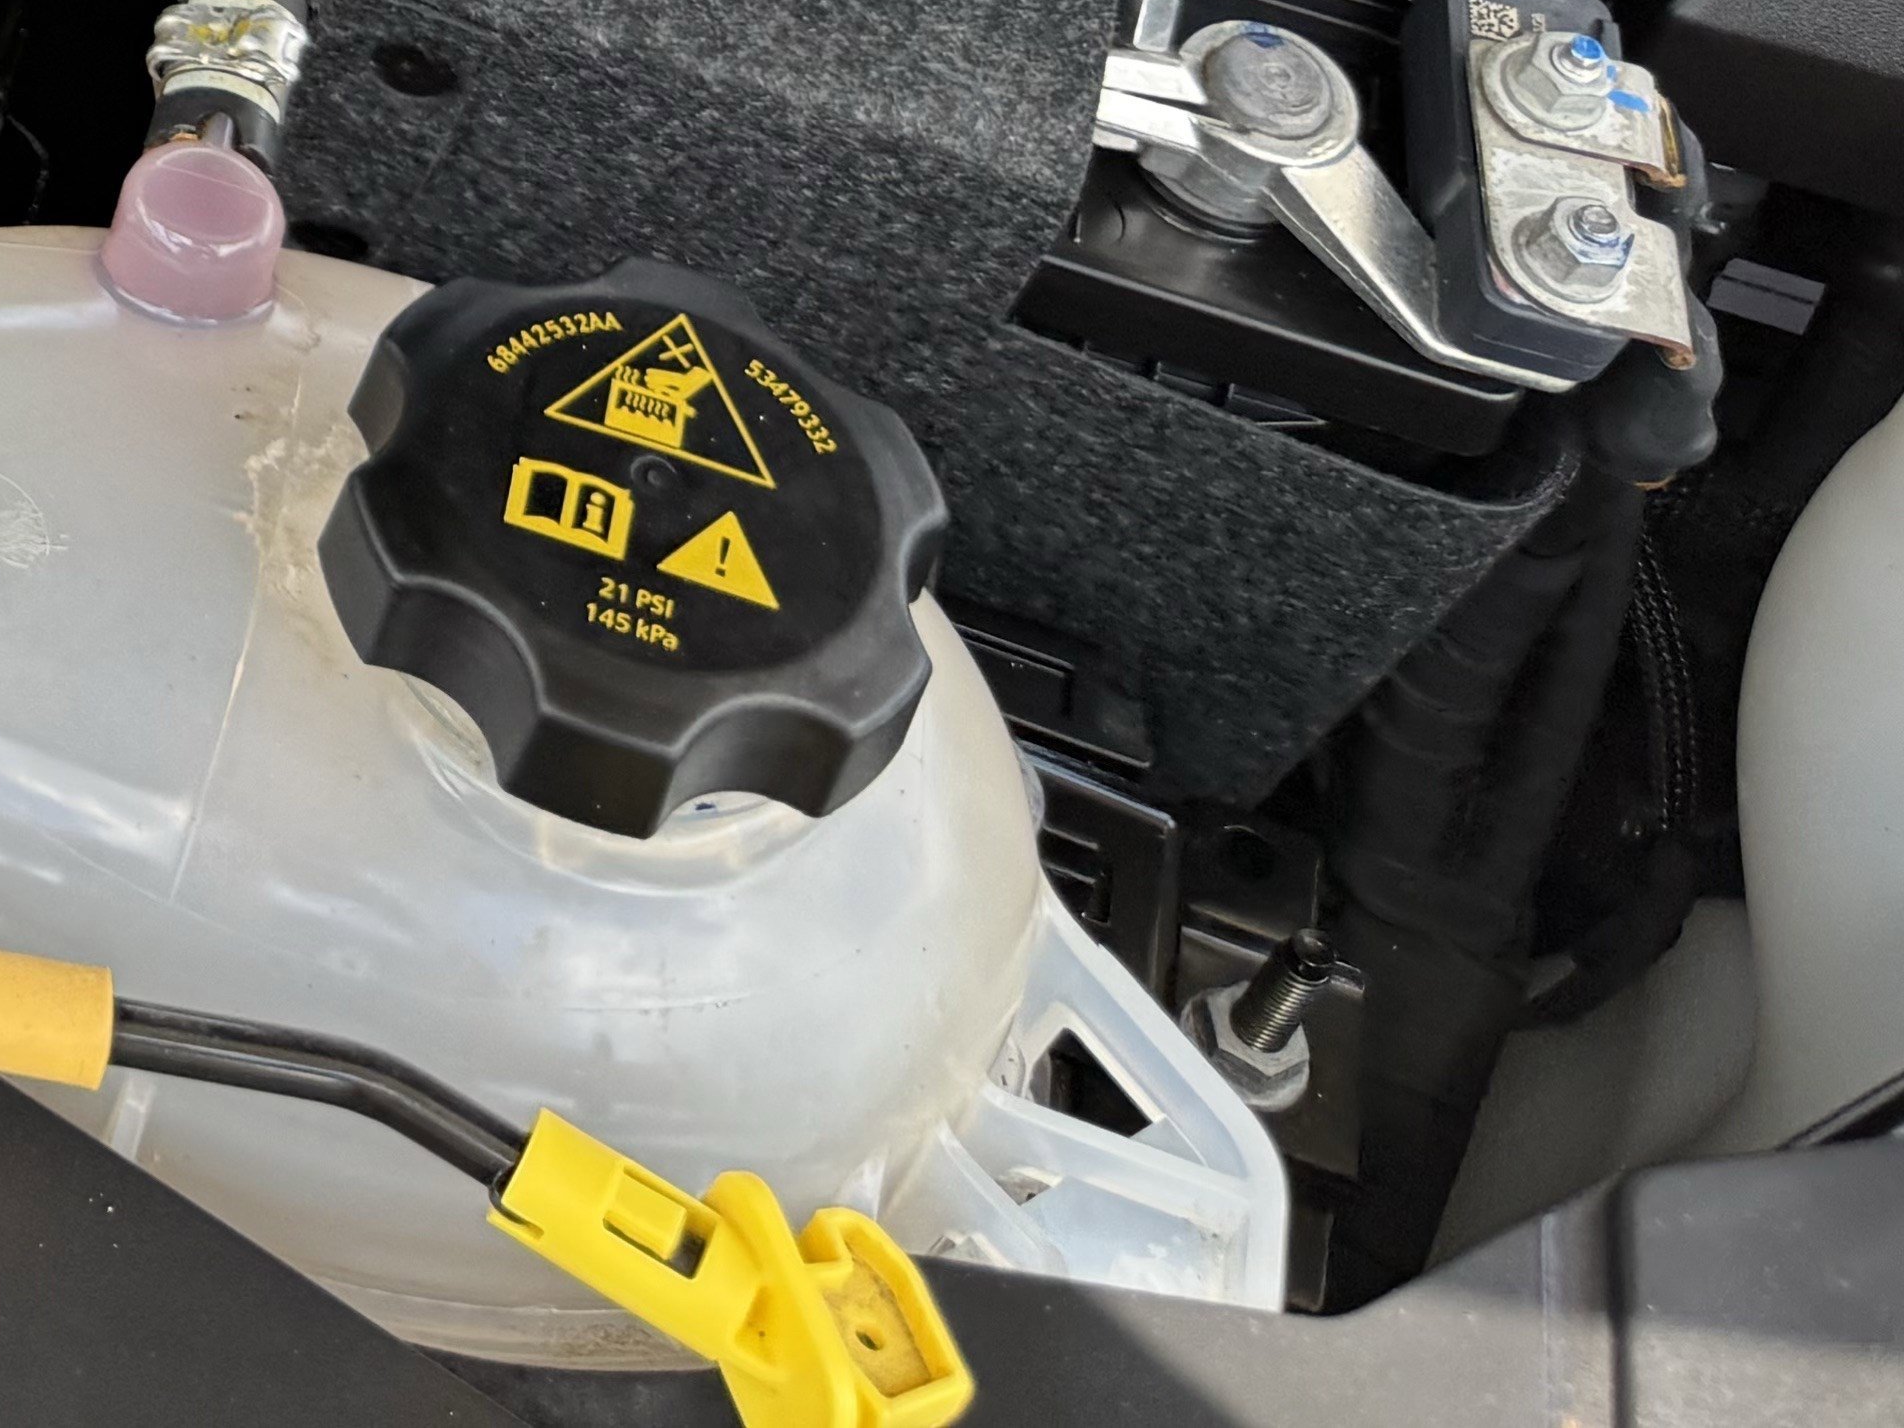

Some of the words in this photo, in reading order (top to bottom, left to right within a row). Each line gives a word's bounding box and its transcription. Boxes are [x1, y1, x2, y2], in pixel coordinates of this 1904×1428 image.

[487, 310, 625, 375] 68442532AA
[744, 359, 839, 456] 53479332
[586, 601, 632, 639] 145
[635, 616, 680, 652] kPa
[598, 576, 630, 604] 21
[635, 587, 675, 621] PSI
